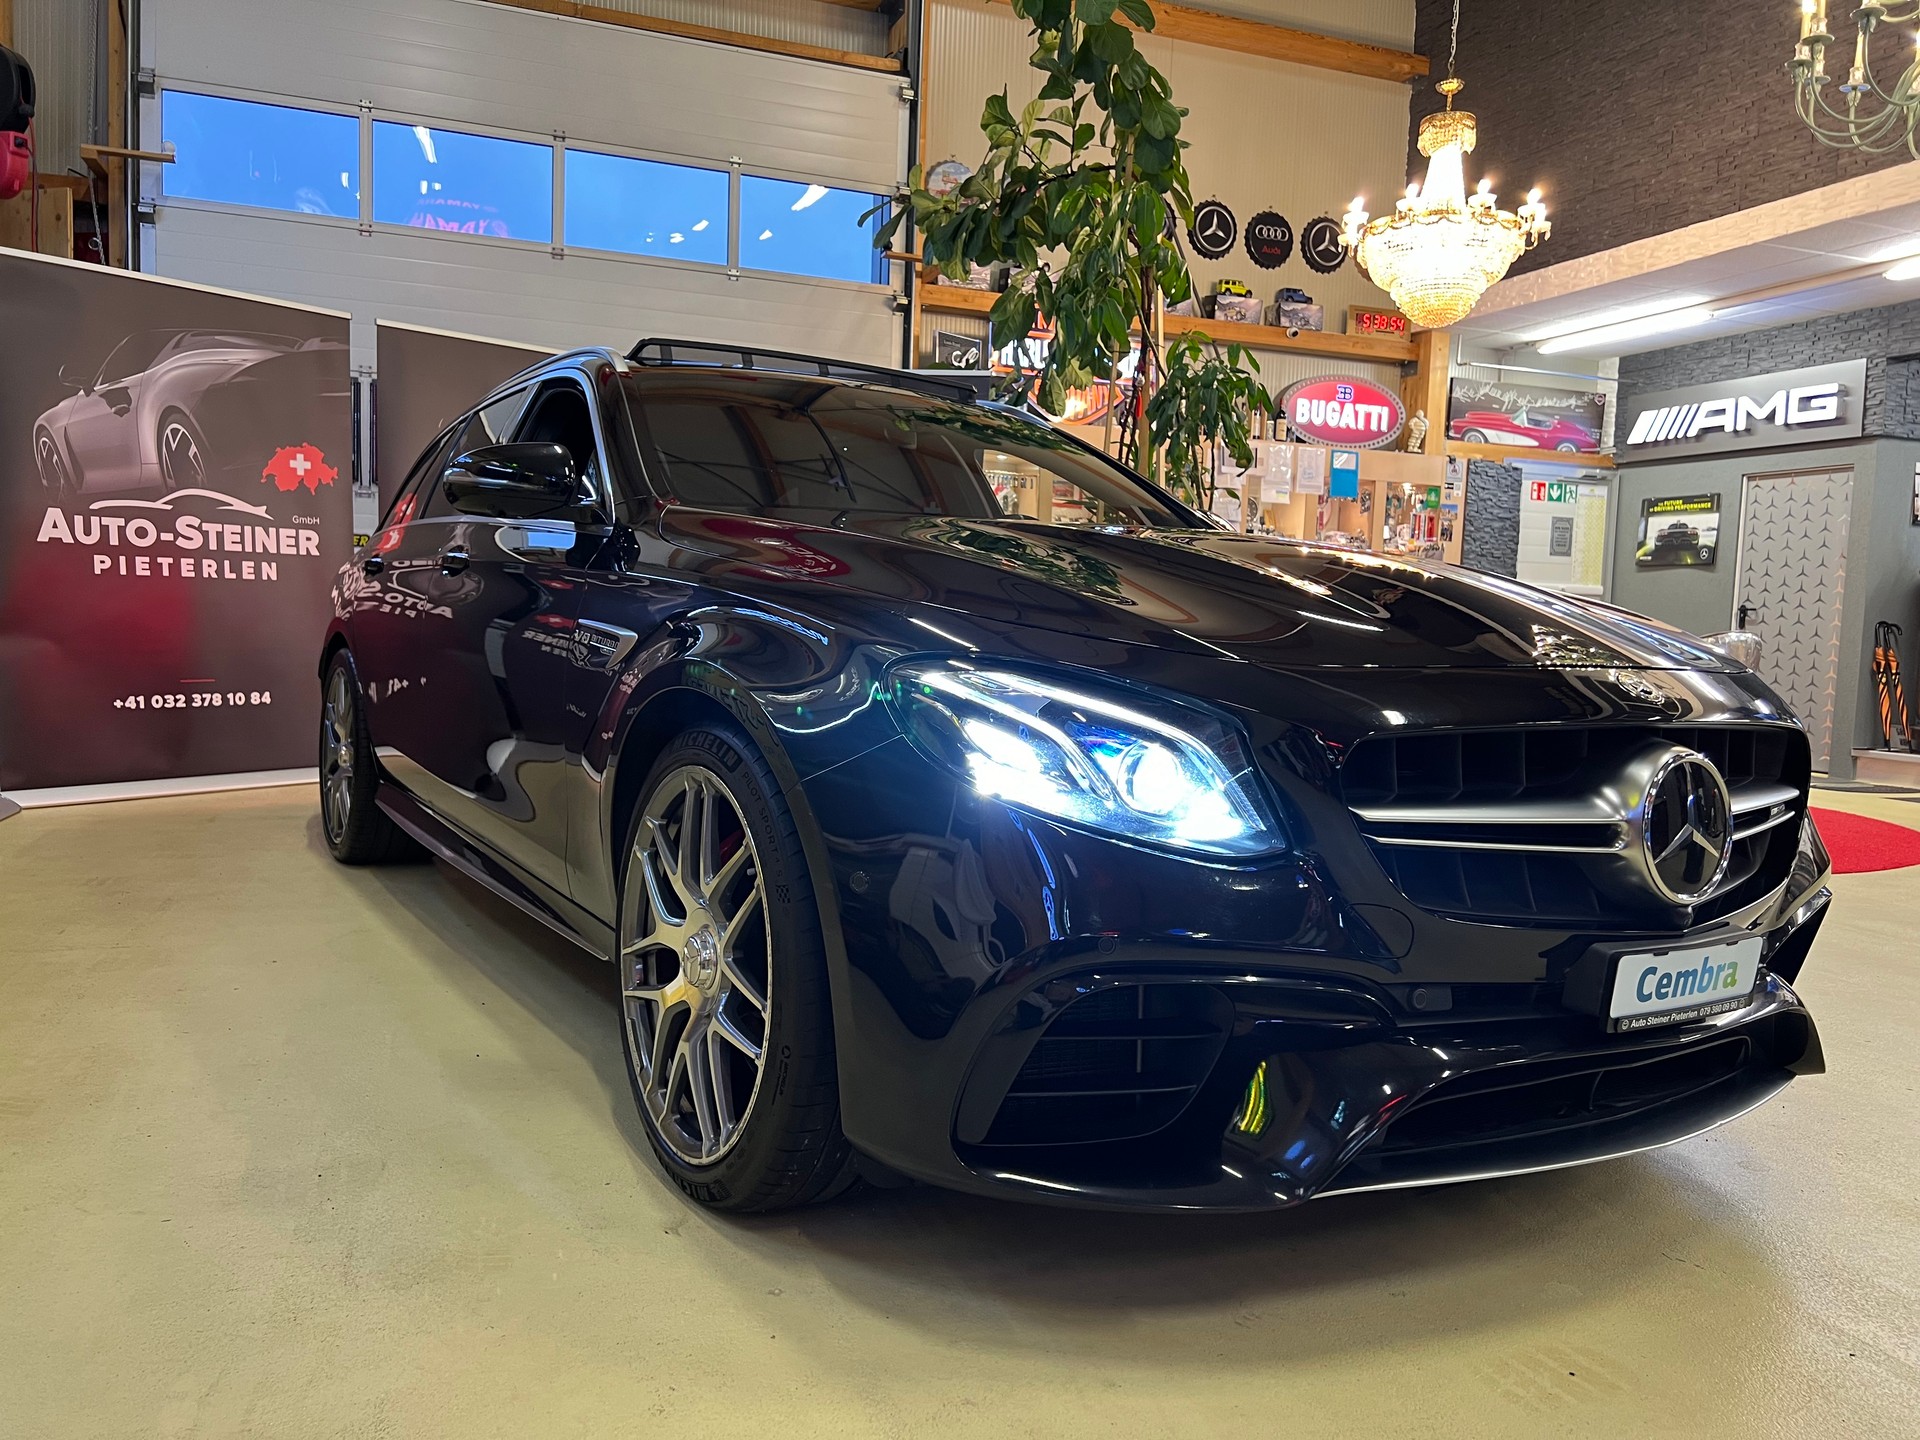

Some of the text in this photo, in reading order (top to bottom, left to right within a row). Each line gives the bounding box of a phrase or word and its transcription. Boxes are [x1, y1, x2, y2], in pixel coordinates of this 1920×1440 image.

[1262, 244, 1281, 255] Audi
[1295, 397, 1389, 432] BUGATTI
[37, 506, 320, 556] AUTO-STEINER
[291, 514, 320, 526] GmbH
[93, 554, 278, 581] PIETERLEN
[113, 691, 271, 709] +41 032 378 10 84
[670, 731, 738, 768] MICHELIN
[743, 771, 761, 802] PILOT
[759, 807, 779, 854] SPORT
[1636, 956, 1739, 1003] Cembra
[1630, 1018, 1646, 1028] Auto
[1647, 1015, 1670, 1026] Steiner
[1670, 1010, 1698, 1022] Pieterlen
